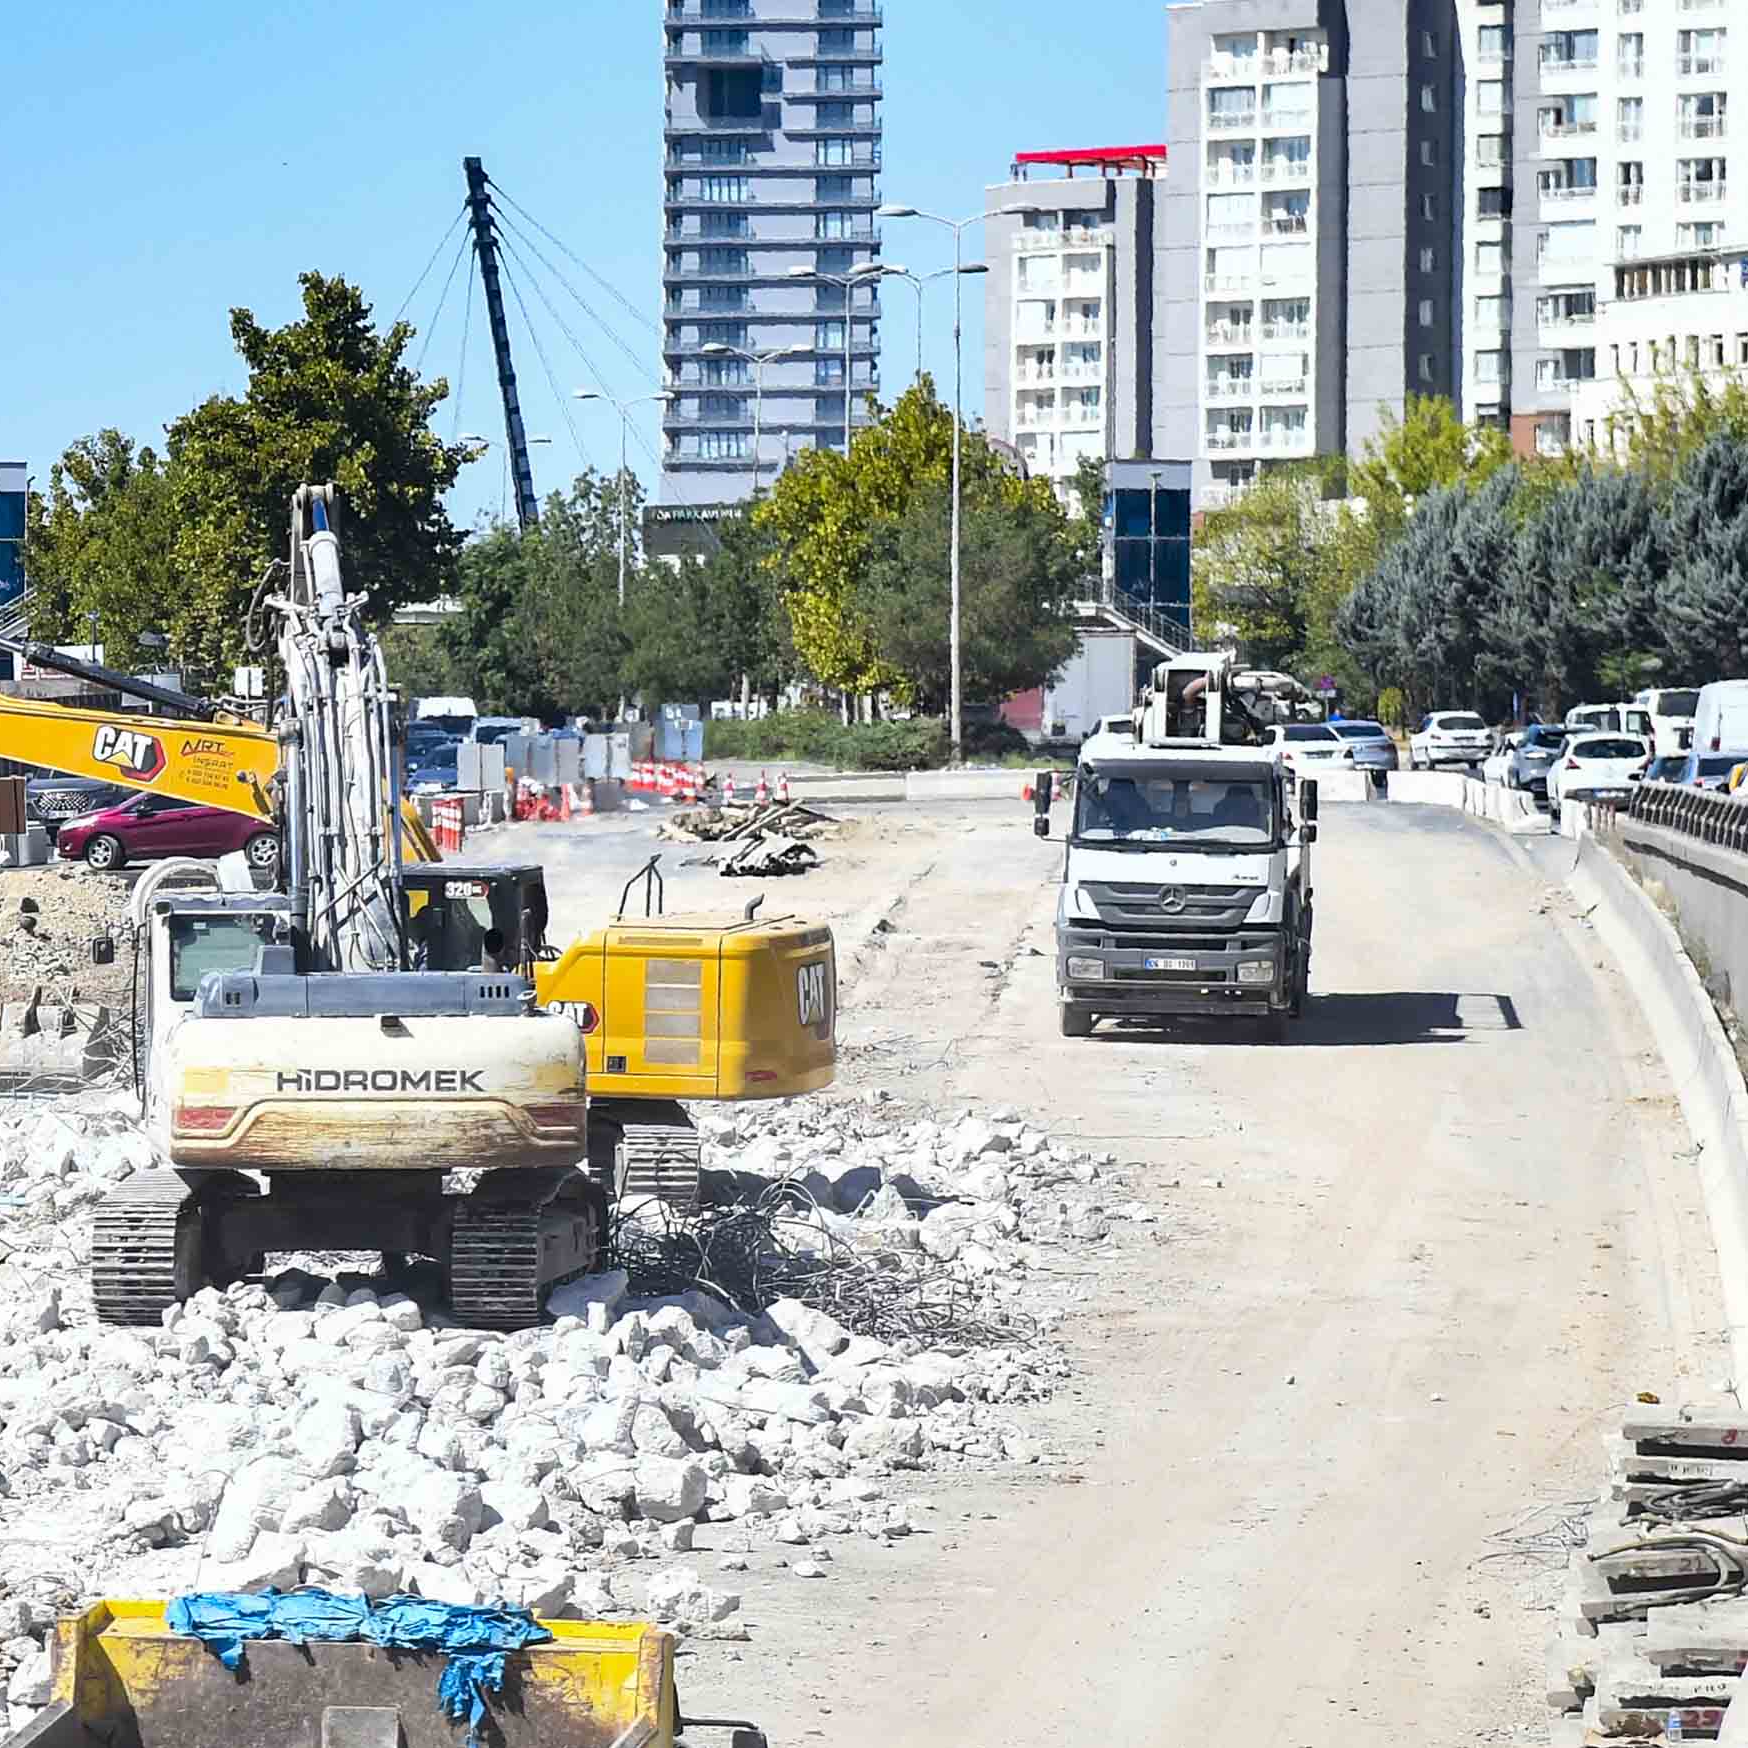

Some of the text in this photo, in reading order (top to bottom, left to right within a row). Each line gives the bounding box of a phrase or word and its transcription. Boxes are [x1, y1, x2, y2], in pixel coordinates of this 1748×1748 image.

[93, 726, 152, 770] CAT
[445, 881, 473, 897] 320
[799, 963, 826, 1025] CAT
